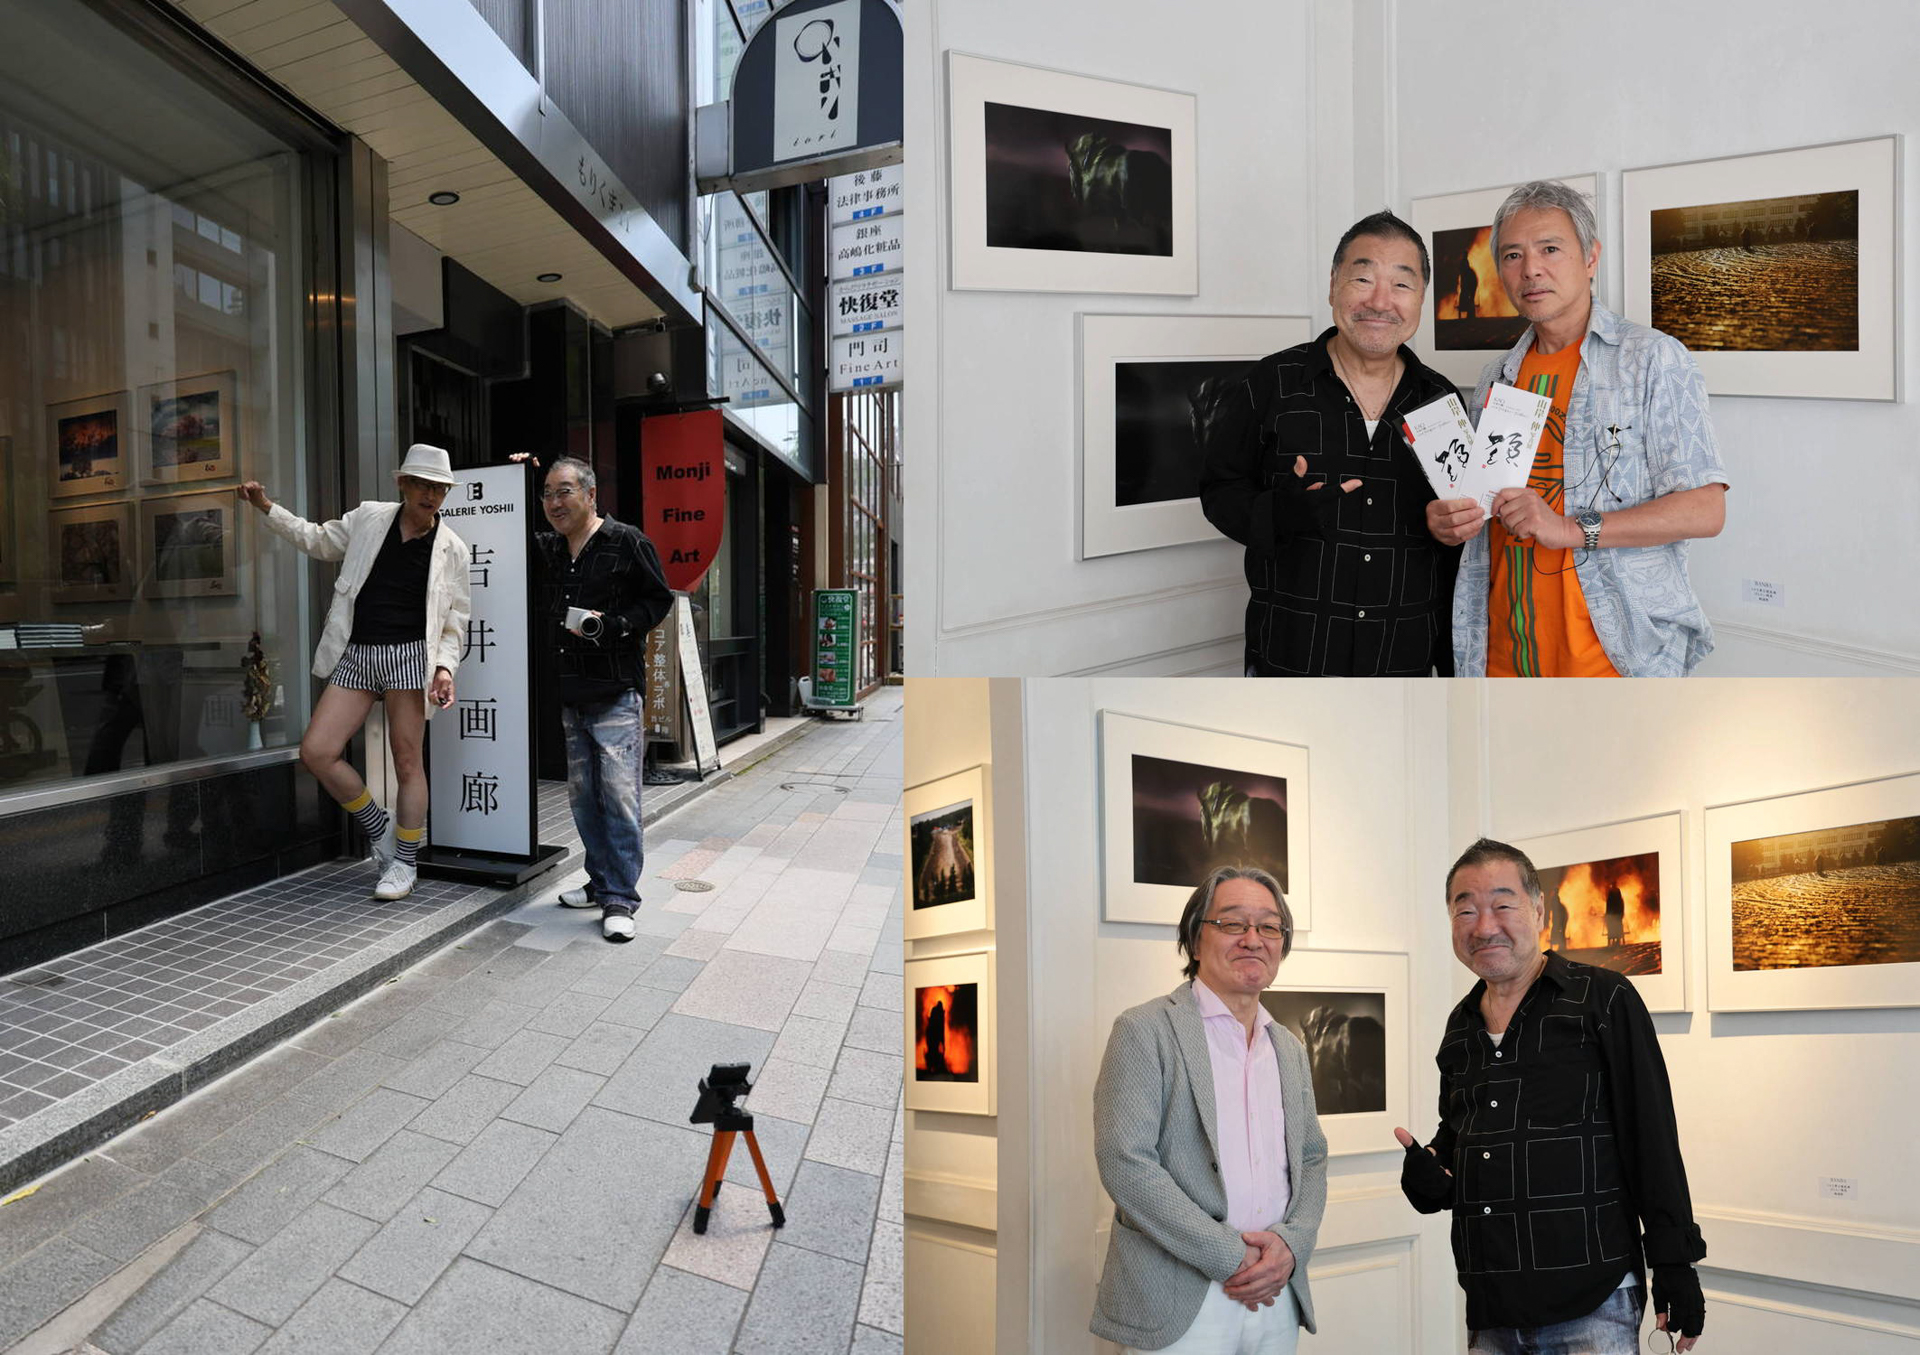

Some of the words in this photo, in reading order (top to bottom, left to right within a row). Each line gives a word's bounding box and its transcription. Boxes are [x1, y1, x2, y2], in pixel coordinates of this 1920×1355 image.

[837, 182, 900, 208] 法律事務所
[856, 224, 882, 240] 銀座
[838, 238, 901, 261] 高嶋化粧品
[838, 289, 899, 316] 快復堂
[848, 337, 888, 358] 門司
[840, 361, 870, 375] Fine
[874, 358, 899, 371] Art
[656, 462, 711, 481] Monji
[439, 506, 477, 517] GALERIE
[480, 503, 514, 515] YOSHII
[662, 508, 706, 523] Fine
[669, 549, 701, 564] Art
[459, 544, 499, 816] 吉井画廊
